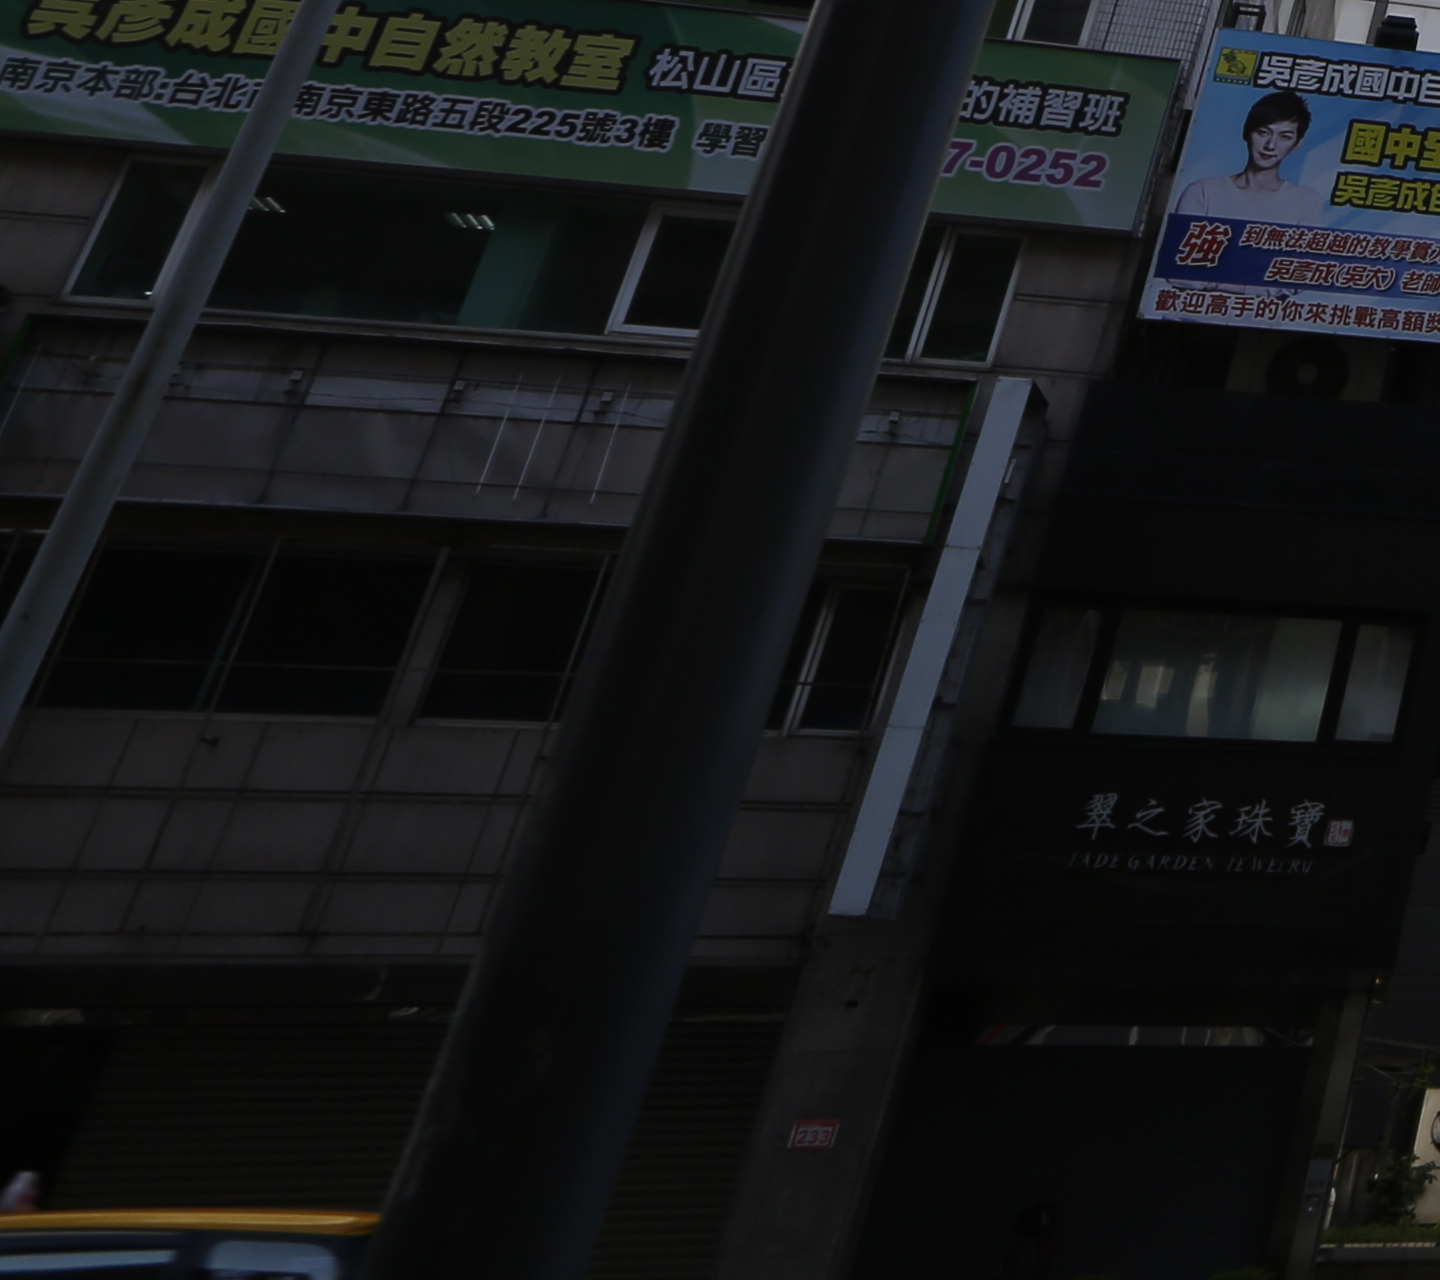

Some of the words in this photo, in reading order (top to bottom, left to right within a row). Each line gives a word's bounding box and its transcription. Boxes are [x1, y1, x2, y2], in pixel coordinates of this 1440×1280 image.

[1176, 221, 1232, 267] 強
[1075, 791, 1327, 849] 翠之家珠寶
[797, 1130, 832, 1145] 233
